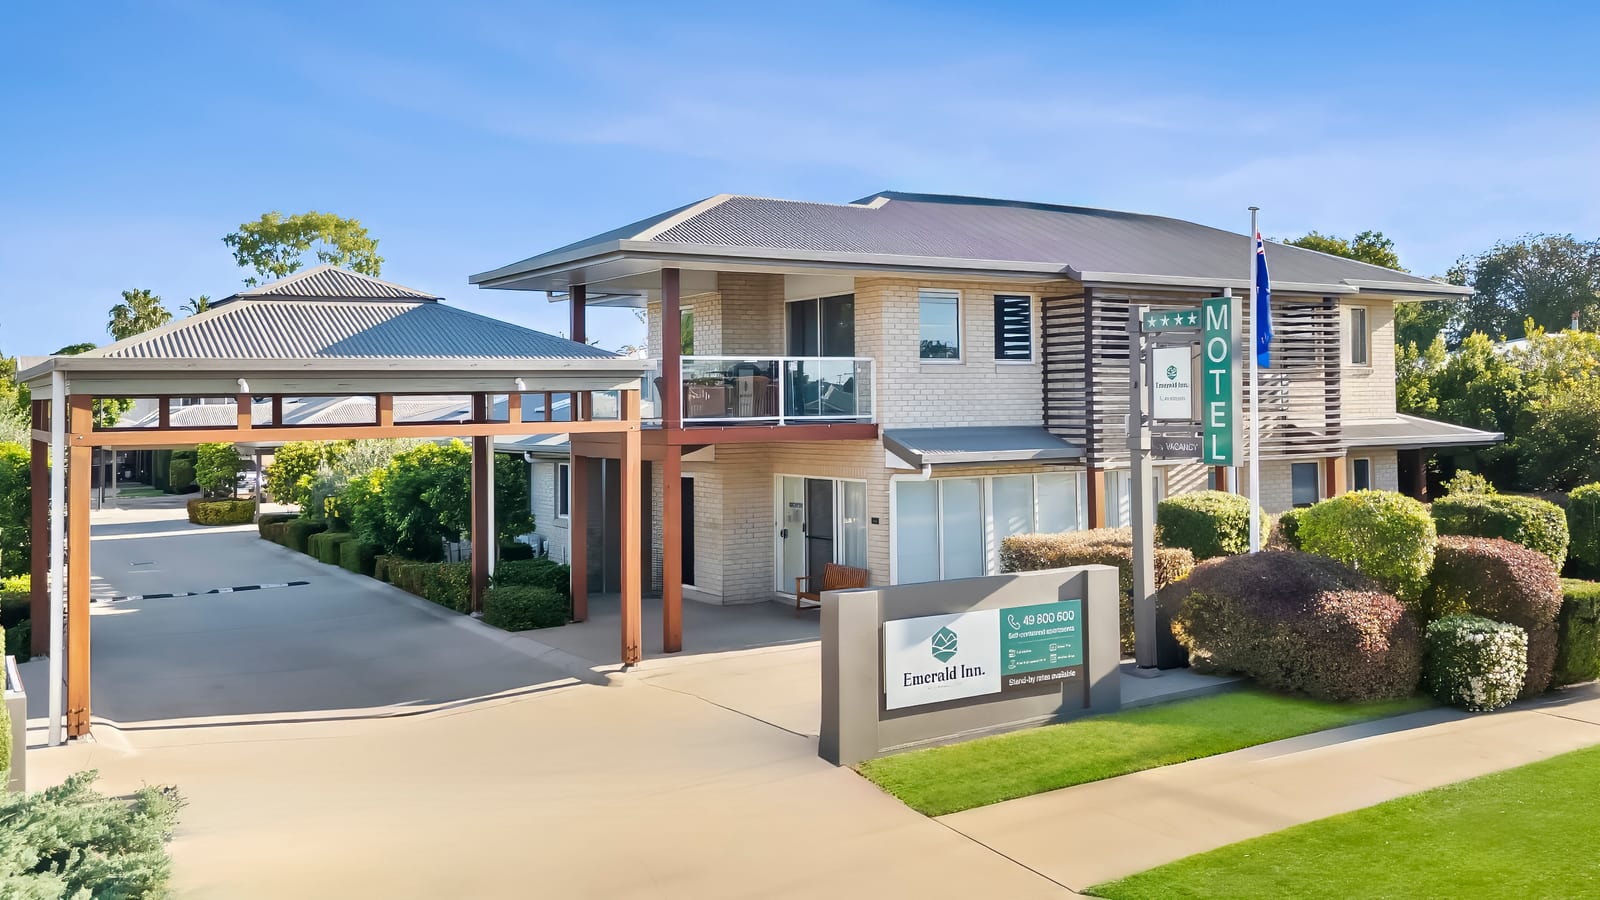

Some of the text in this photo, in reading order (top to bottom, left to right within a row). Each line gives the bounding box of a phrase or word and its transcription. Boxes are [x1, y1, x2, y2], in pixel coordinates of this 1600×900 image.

[1206, 304, 1228, 460] MOTEL
[1165, 442, 1199, 451] VACANCY
[1023, 615, 1035, 625] 49
[1057, 610, 1075, 622] 600
[903, 666, 957, 687] Emerald
[961, 664, 985, 679] Inn.
